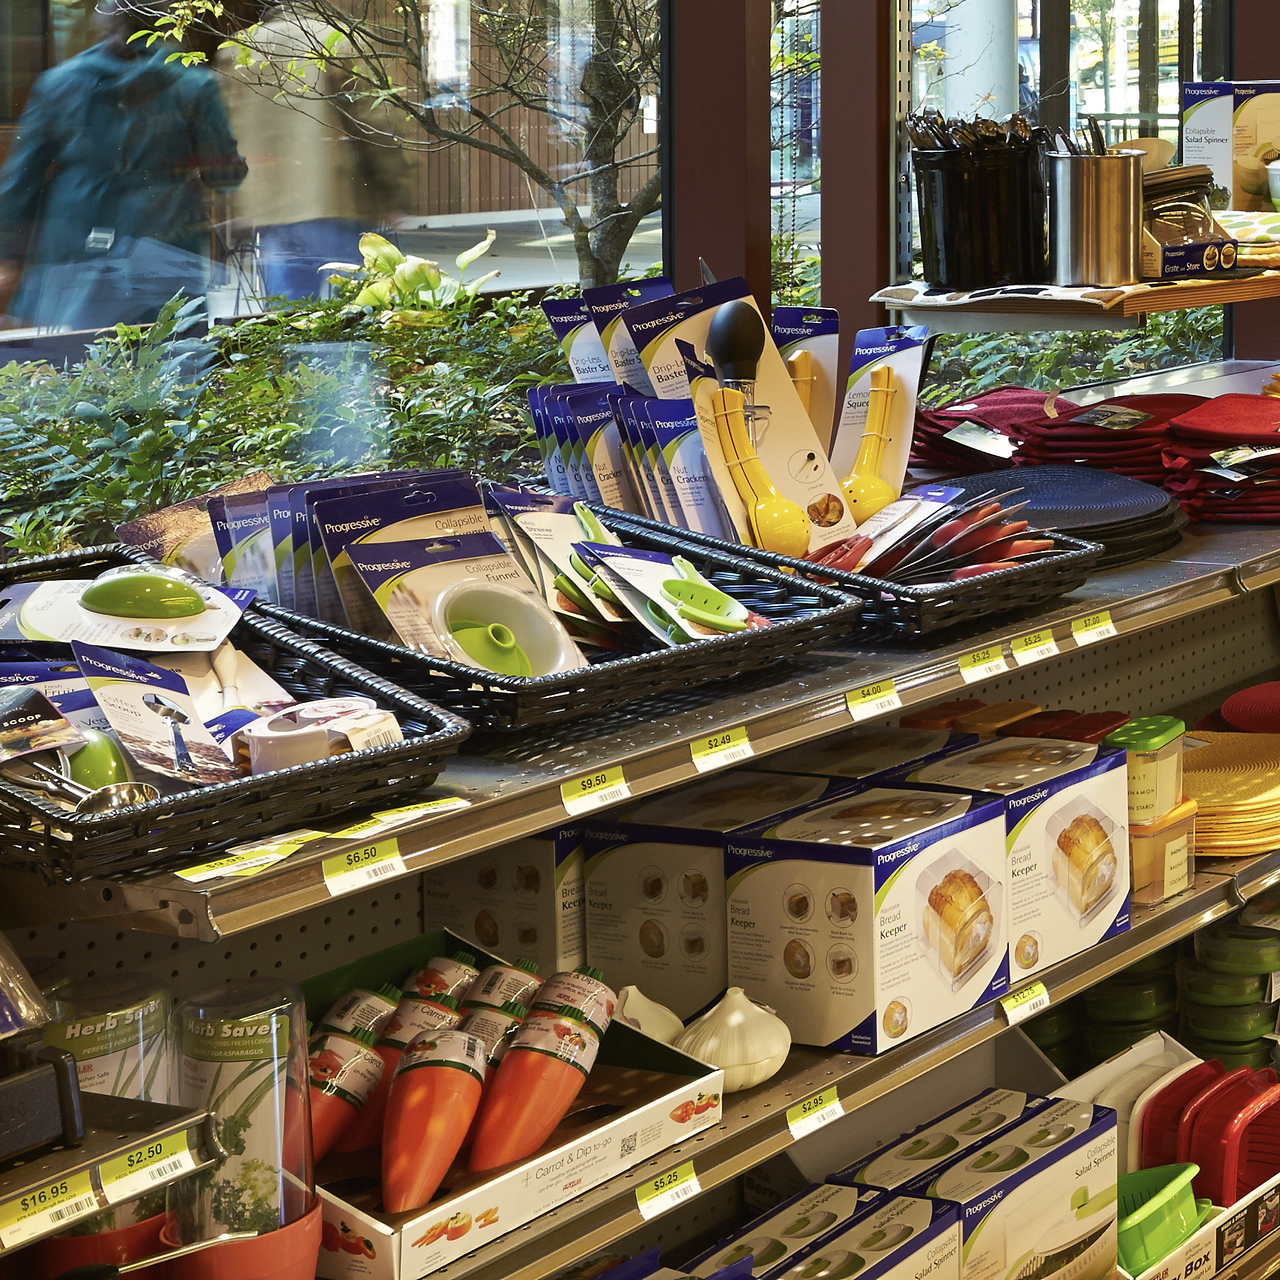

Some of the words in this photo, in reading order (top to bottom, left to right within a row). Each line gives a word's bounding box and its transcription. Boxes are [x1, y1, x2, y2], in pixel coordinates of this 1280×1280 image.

[1185, 88, 1219, 96] Progressive
[1185, 127, 1216, 135] Collapsible
[1185, 136, 1202, 144] Salad
[1204, 136, 1228, 145] Spinner
[1165, 264, 1179, 274] Grate
[1186, 262, 1201, 271] Store
[592, 300, 629, 313] Progressive
[550, 313, 587, 323] Progressive
[632, 311, 685, 332] Progressive
[774, 325, 813, 335] Progressive
[575, 365, 598, 374] Baster
[600, 363, 611, 372] Set
[599, 470, 623, 482] Cracker
[676, 475, 708, 484] Cracker
[325, 514, 381, 534] Progressive
[435, 513, 483, 531] Collapsible
[358, 558, 411, 572] Progressive
[465, 559, 512, 574] Collapsible
[485, 569, 521, 584] Funnel
[1084, 616, 1100, 628] $7.00
[1024, 634, 1042, 646] $5.25
[972, 650, 990, 663] $5.25
[81, 654, 149, 684] Progressive
[861, 685, 882, 698] $4.00
[708, 735, 732, 751] $2.49
[581, 773, 607, 791] $9.50
[1009, 787, 1049, 809] Progressive
[346, 847, 378, 866] $6.50
[877, 841, 920, 865] Progressive
[1011, 852, 1032, 866] Bread
[1011, 862, 1038, 879] Keeper
[879, 911, 901, 926] Bread
[880, 922, 907, 941] Keeper
[65, 1012, 118, 1040] Herb
[221, 1020, 283, 1038] Saver
[801, 1095, 824, 1113] $2.95
[127, 1142, 163, 1168] $2.50
[1087, 1135, 1117, 1160] Collapsible
[536, 1158, 564, 1180] Carrot
[567, 1153, 573, 1164] &
[576, 1146, 592, 1160] Dip
[1074, 1159, 1095, 1180] Salad
[1094, 1146, 1117, 1170] Spinner
[654, 1171, 679, 1192] $5.25
[20, 1182, 68, 1212] $16.95
[965, 1189, 1005, 1218] Progressive
